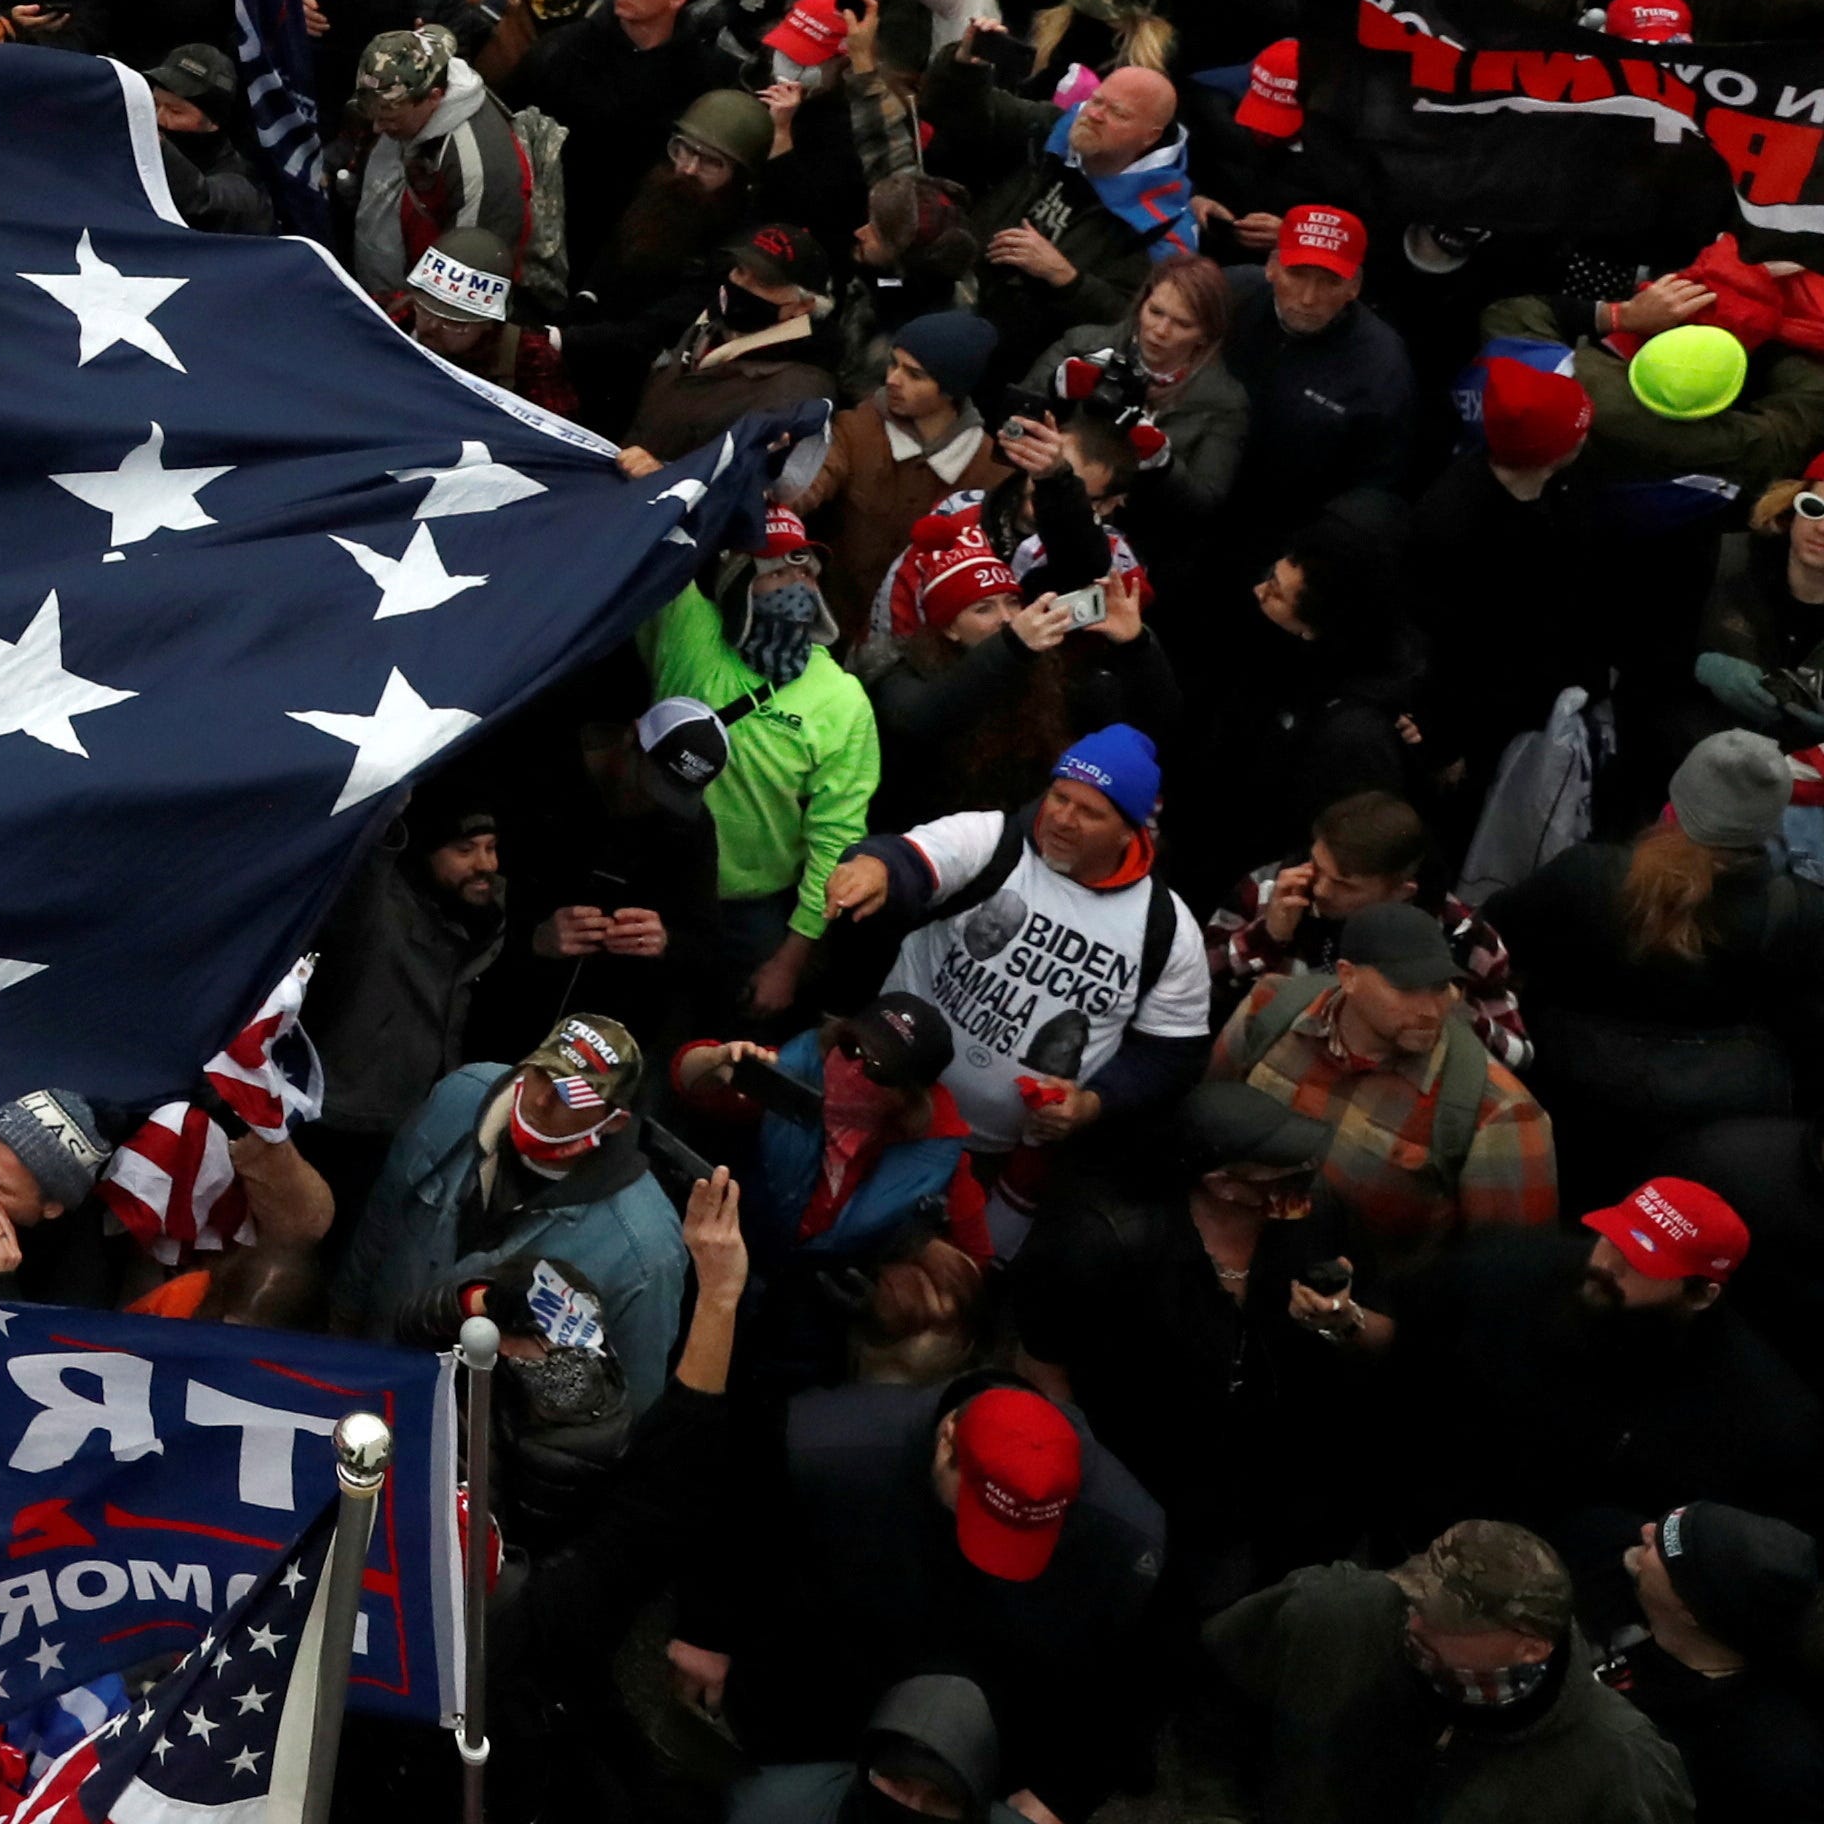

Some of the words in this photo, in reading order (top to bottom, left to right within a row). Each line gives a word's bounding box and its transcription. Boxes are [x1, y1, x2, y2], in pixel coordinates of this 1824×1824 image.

[1631, 4, 1681, 22] Trump
[1295, 222, 1350, 242] AMERICA
[1308, 211, 1341, 226] KEEP
[1298, 234, 1341, 251] GREAT
[420, 267, 496, 307] PENCE
[424, 252, 506, 297] TRUMP
[1063, 754, 1112, 787] Trump
[1023, 909, 1138, 993] BIDEN
[944, 948, 1043, 1031] KAMALA
[1007, 943, 1123, 1022] SUCKS!
[931, 972, 1026, 1063] SWALLOWS!
[560, 1043, 588, 1069] 2020
[567, 1019, 620, 1065] TRUMP
[1633, 1196, 1686, 1242] GREAT!!!
[1656, 1193, 1701, 1238] AMERICA
[984, 1481, 1018, 1507] MAKE
